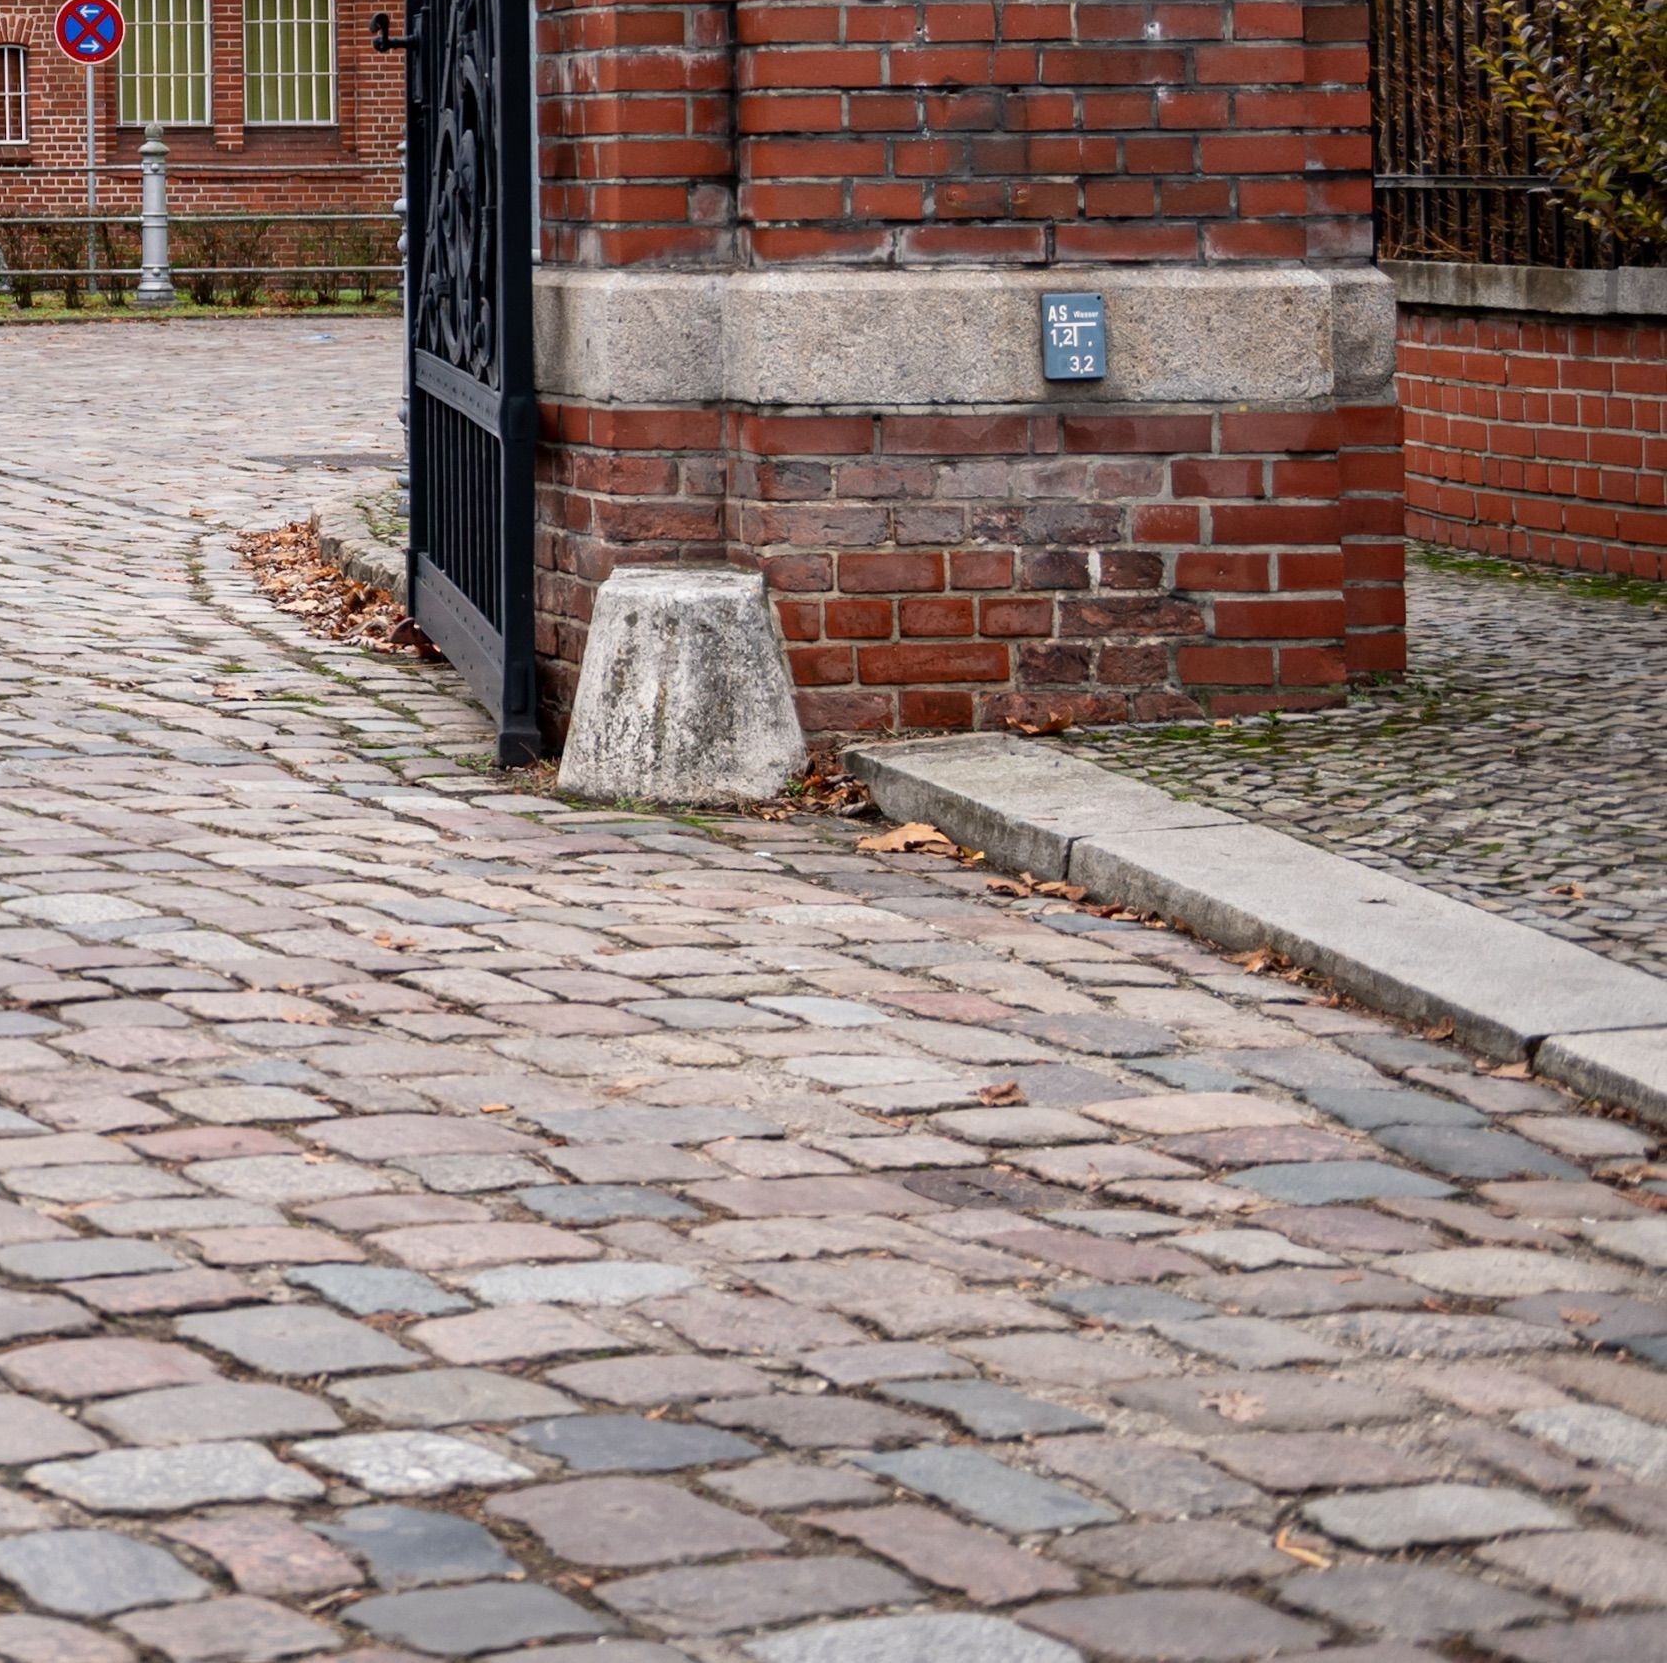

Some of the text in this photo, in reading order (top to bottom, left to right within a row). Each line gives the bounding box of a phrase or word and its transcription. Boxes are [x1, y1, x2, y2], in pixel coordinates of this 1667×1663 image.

[1048, 304, 1067, 322] AS
[1050, 328, 1073, 348] 1,2
[1069, 355, 1094, 374] 3,2
